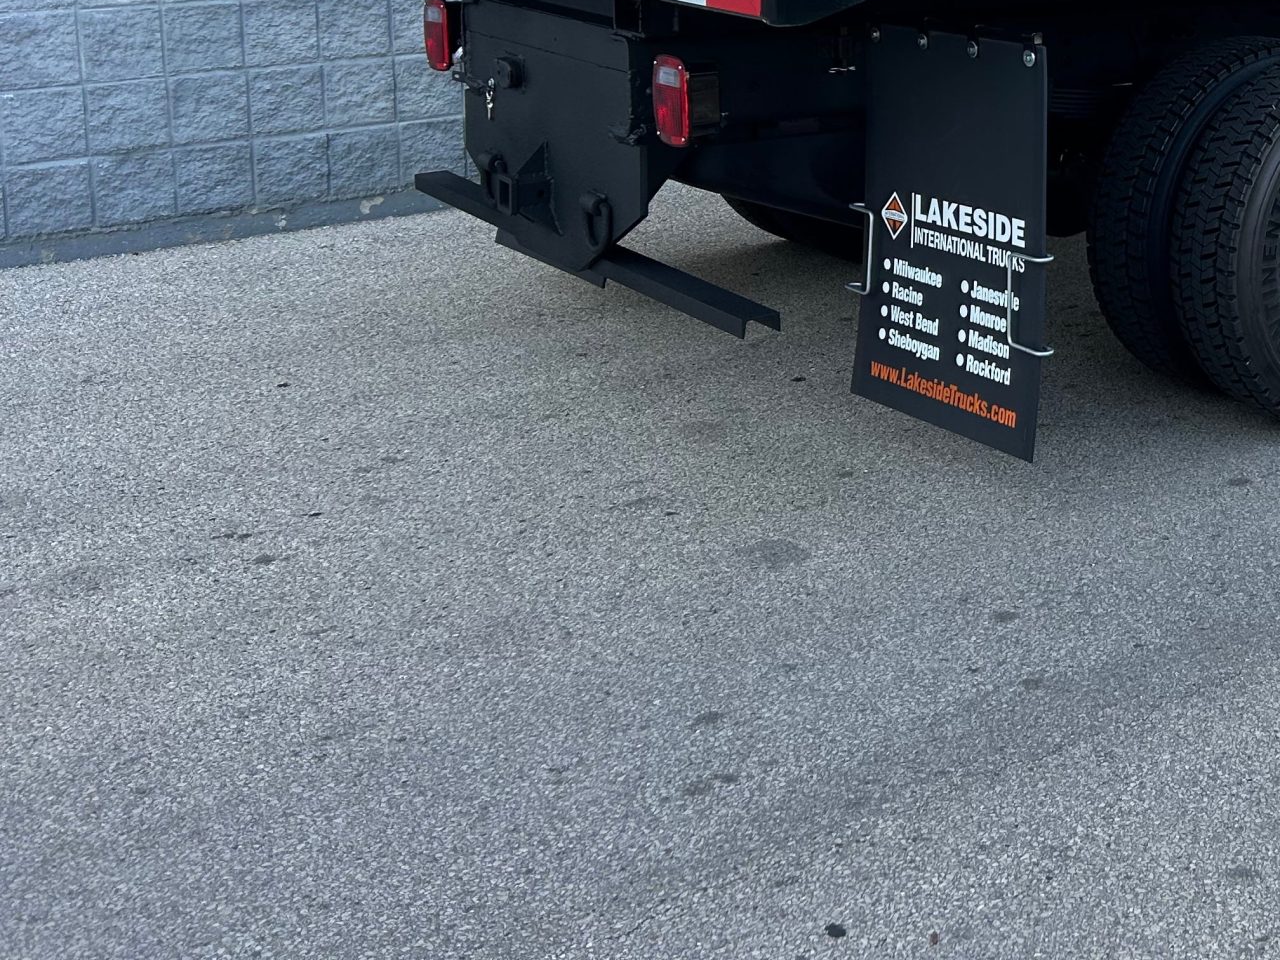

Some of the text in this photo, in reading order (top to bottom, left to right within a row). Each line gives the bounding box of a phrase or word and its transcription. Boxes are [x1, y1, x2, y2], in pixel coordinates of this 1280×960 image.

[915, 194, 1026, 248] LAKESIDE
[914, 226, 986, 262] INTERNATIONAL
[893, 258, 943, 288] Milwaukee
[892, 281, 924, 306] Racine
[970, 280, 1020, 311] Janesvile
[890, 304, 939, 336] West Bend
[969, 304, 1007, 332] Monroe
[888, 328, 940, 361] Sheboygan
[968, 329, 1010, 359] Madison
[965, 354, 1011, 385] Rockford
[870, 360, 1017, 428] www.LakesideTrucks.com
